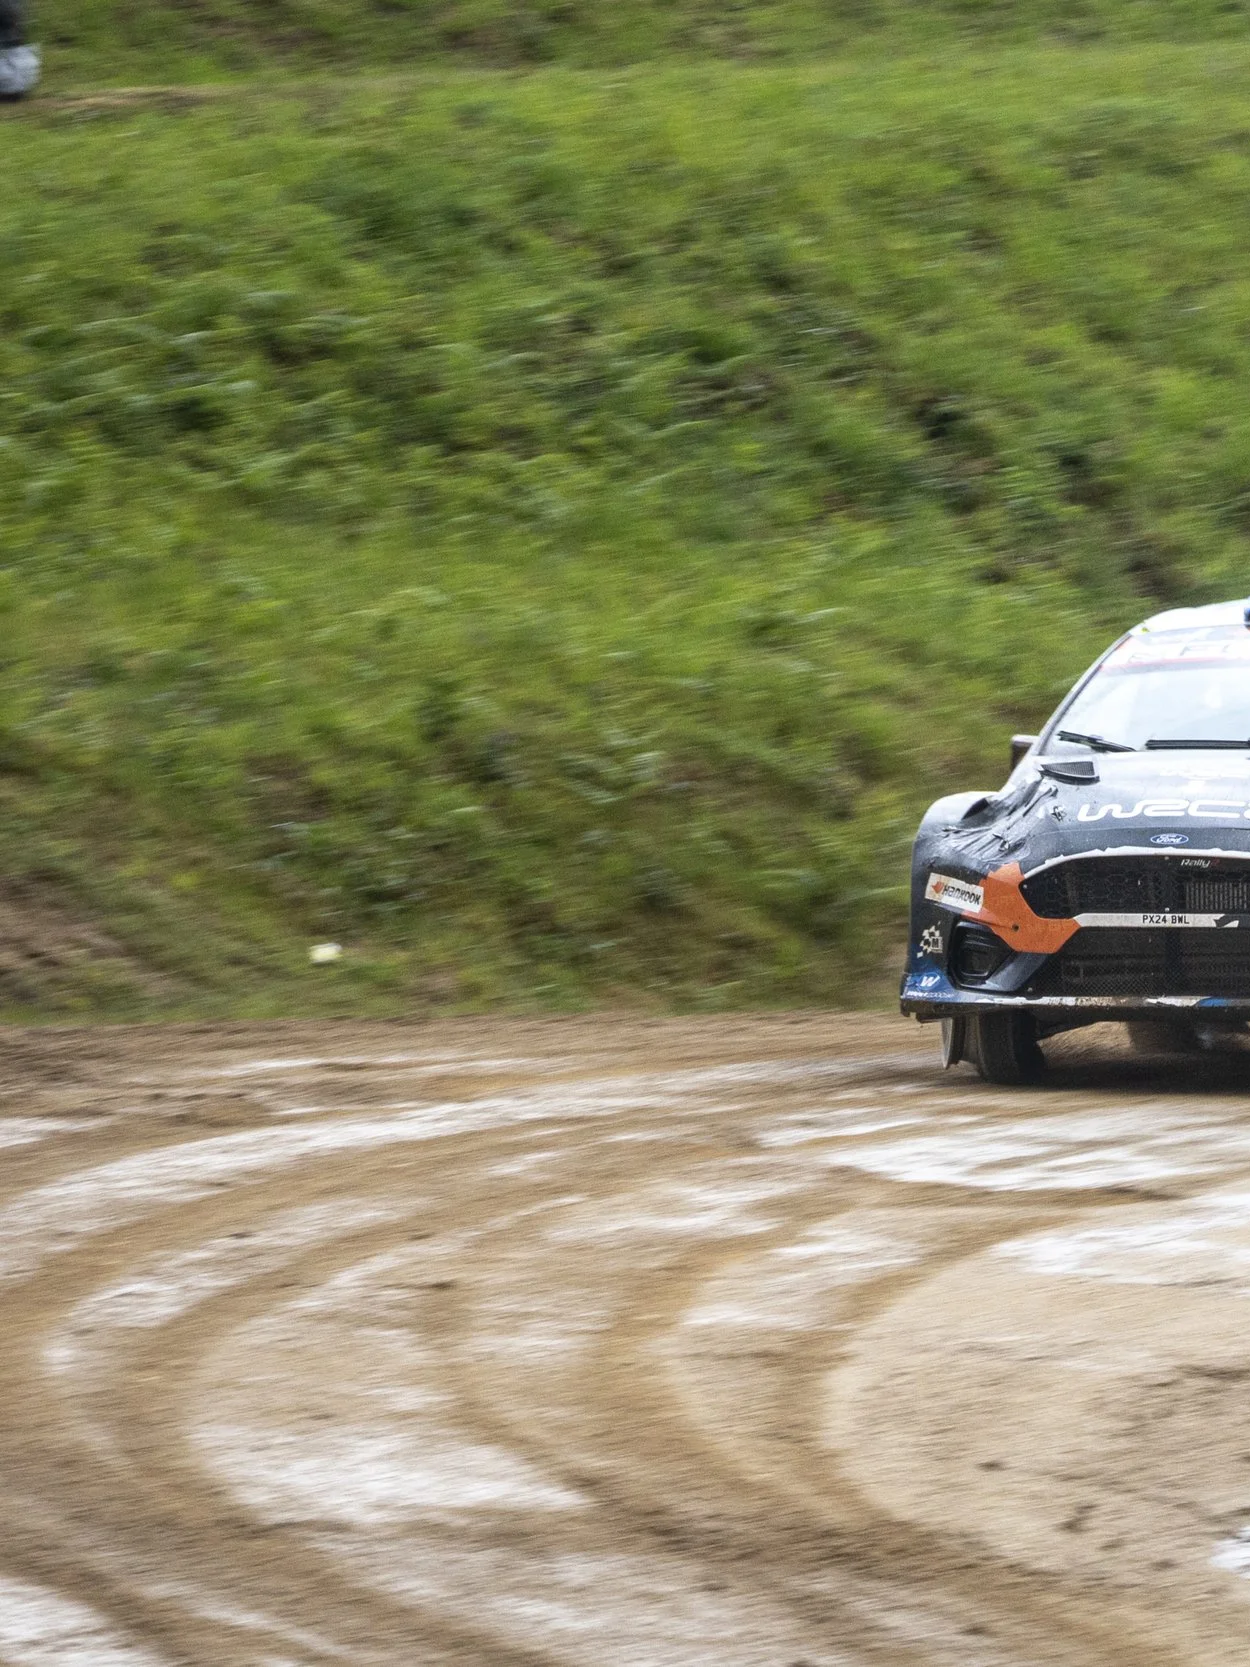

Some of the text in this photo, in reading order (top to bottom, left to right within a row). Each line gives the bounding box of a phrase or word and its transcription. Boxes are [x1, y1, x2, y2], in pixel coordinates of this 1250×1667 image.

[1155, 833, 1183, 844] Ford
[1142, 914, 1190, 925] PX24 BWL
[919, 975, 941, 987] W
